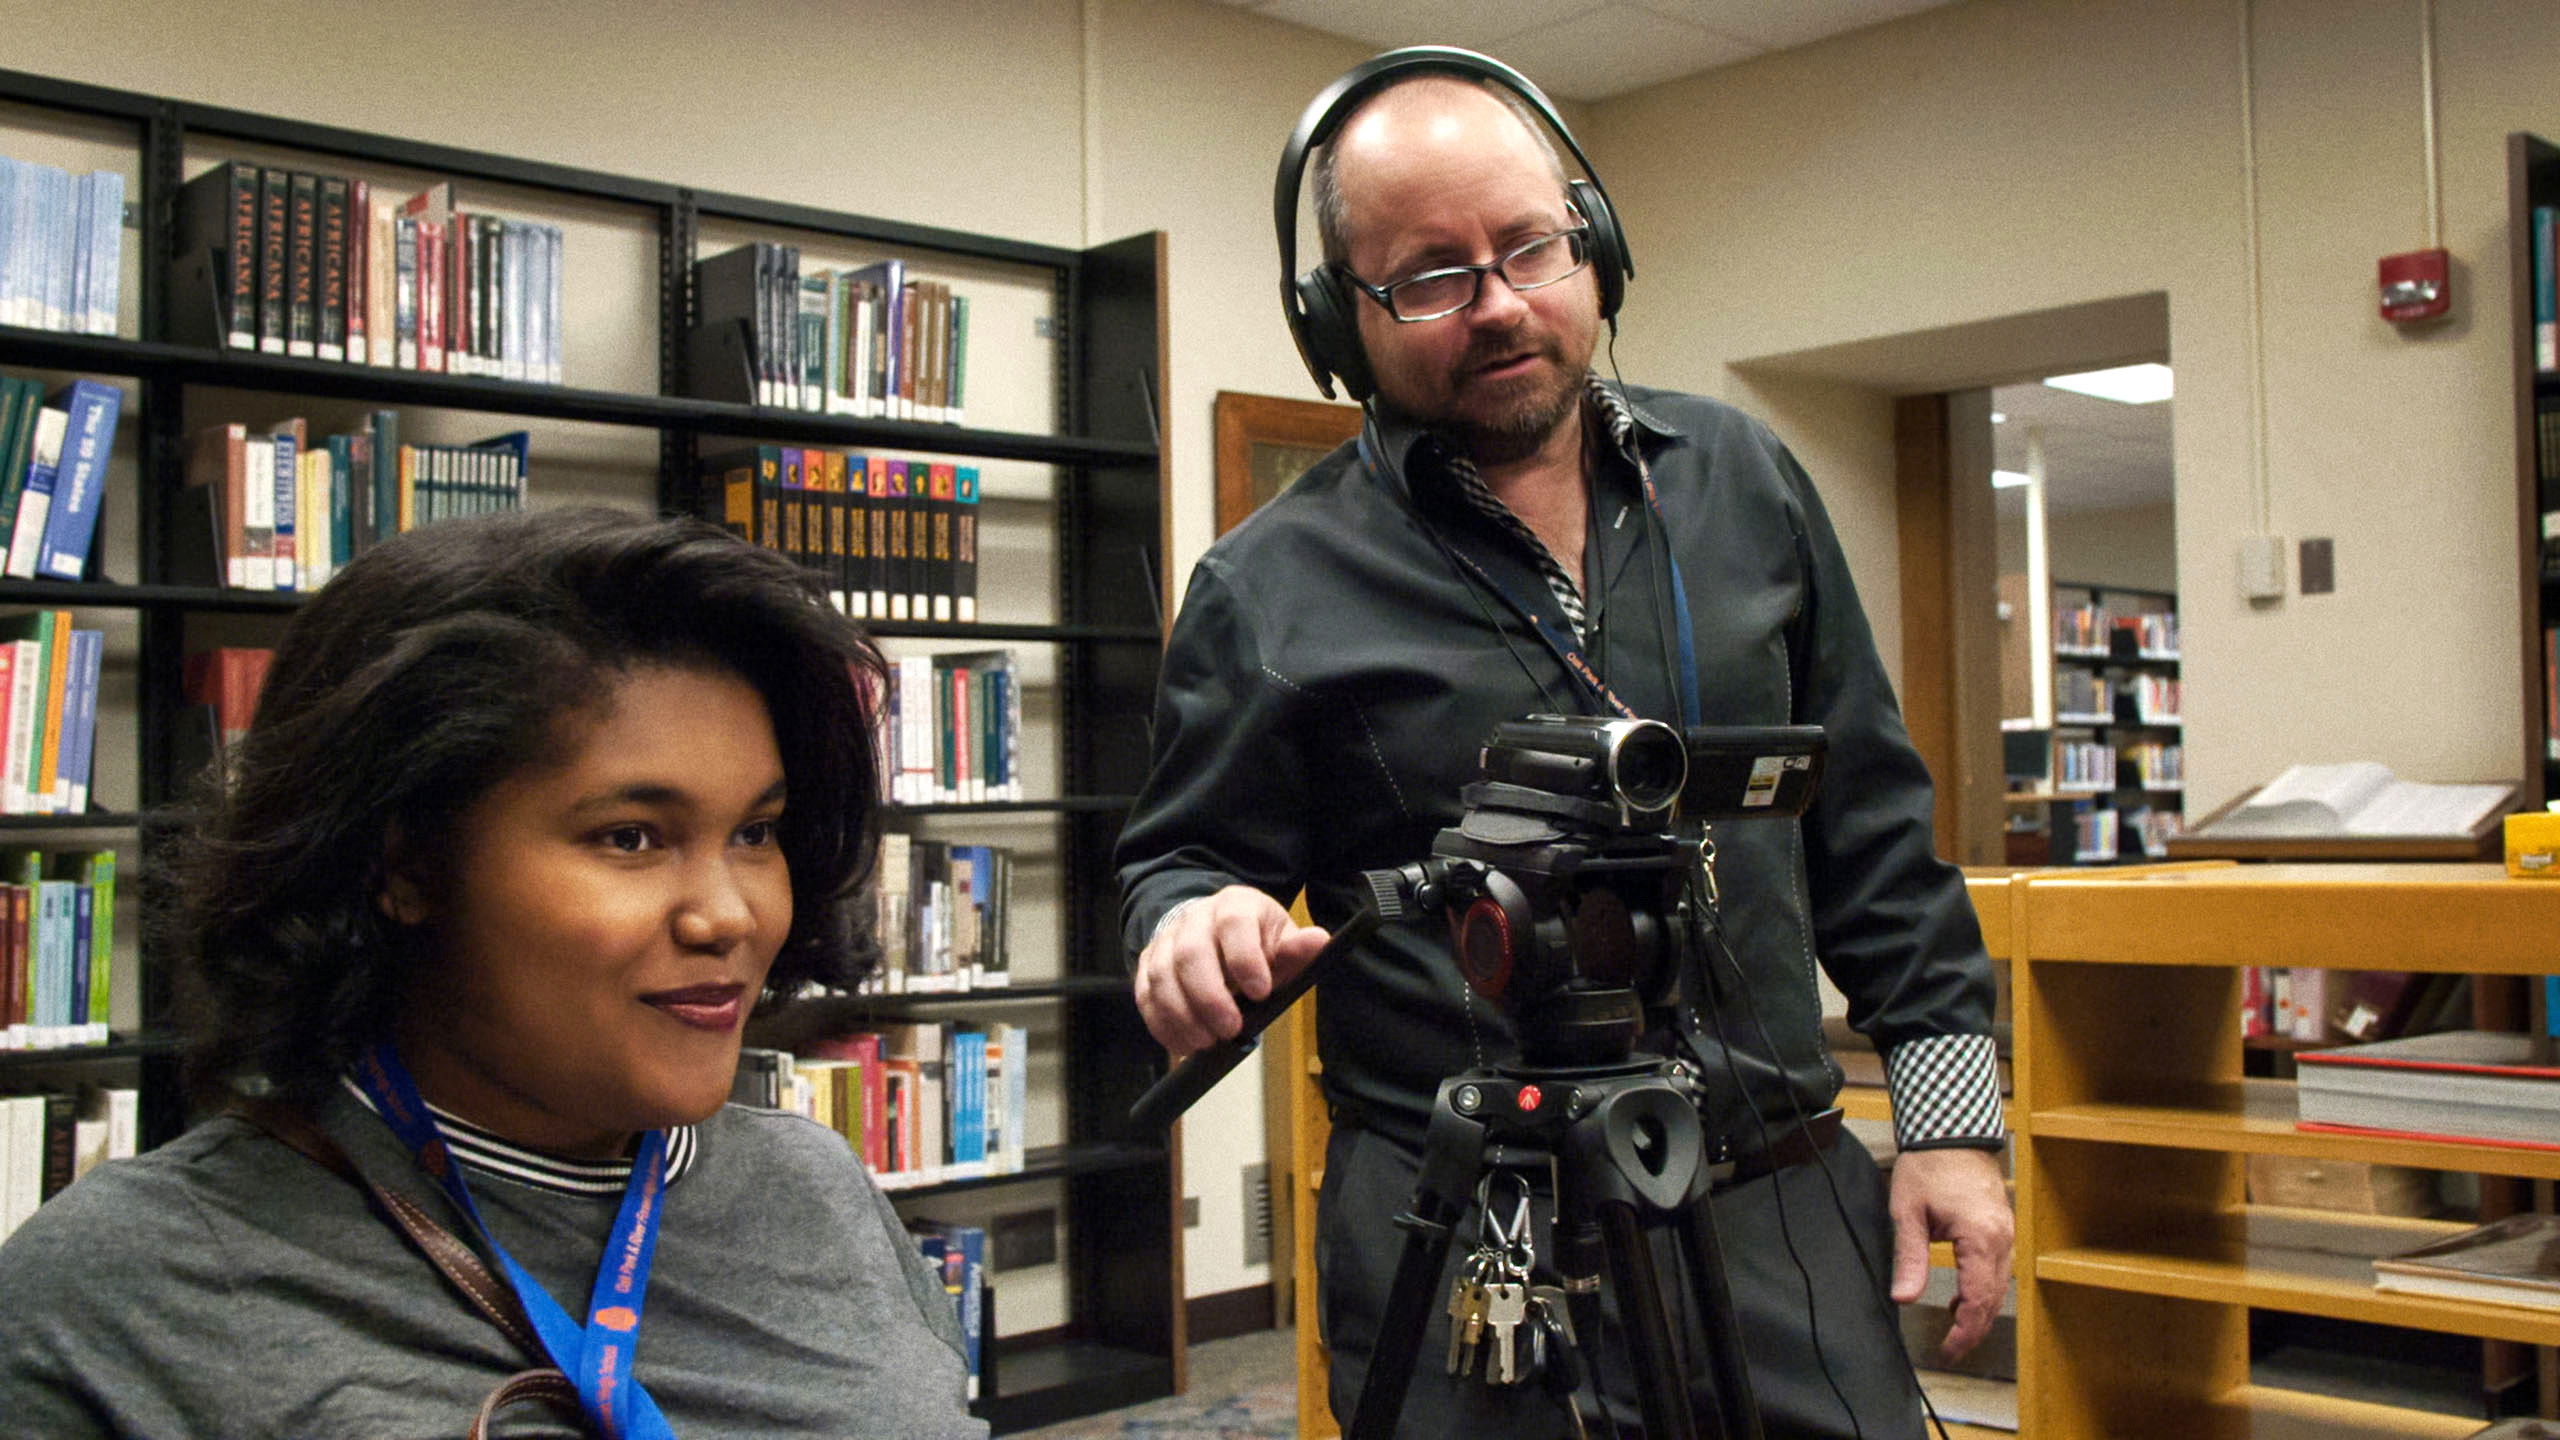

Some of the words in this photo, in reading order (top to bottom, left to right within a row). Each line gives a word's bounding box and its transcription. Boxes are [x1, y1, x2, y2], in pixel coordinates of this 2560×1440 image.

[235, 190, 253, 295] AFRICANA
[266, 195, 284, 299] AFRICANA
[297, 201, 313, 303] AFRICANA
[325, 204, 342, 307] AFRICANA
[84, 404, 104, 434] The
[78, 437, 96, 459] 50
[67, 461, 91, 513] States
[628, 1223, 647, 1245] River
[614, 1275, 632, 1294] Oak
[619, 1254, 638, 1275] Park
